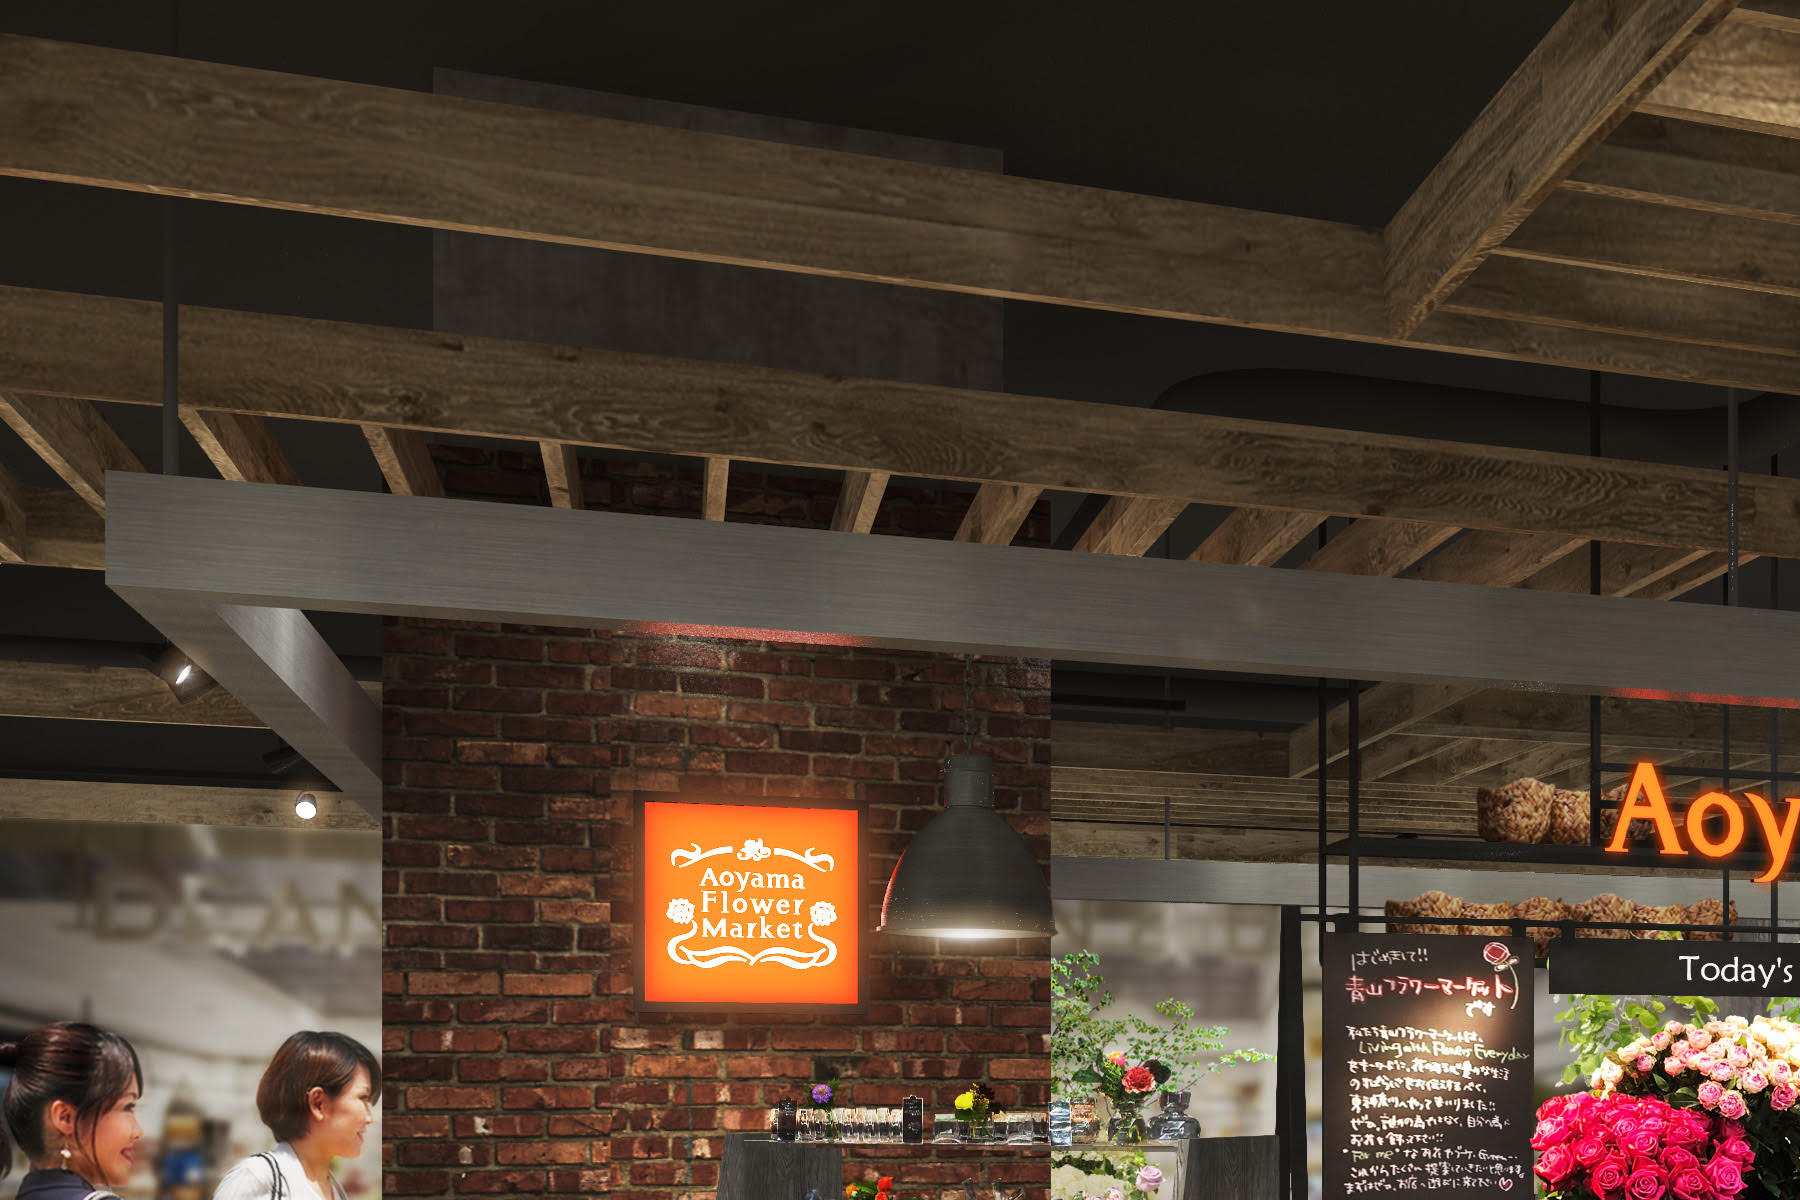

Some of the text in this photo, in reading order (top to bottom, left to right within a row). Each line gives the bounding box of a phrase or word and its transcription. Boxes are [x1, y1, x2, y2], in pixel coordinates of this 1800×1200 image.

[699, 867, 806, 893] Aoyama
[701, 889, 805, 916] Flower
[701, 915, 804, 940] Market
[1678, 955, 1794, 989] Today's
[1344, 974, 1514, 1003] 青山フラワーマーケット
[1465, 1000, 1496, 1018] です
